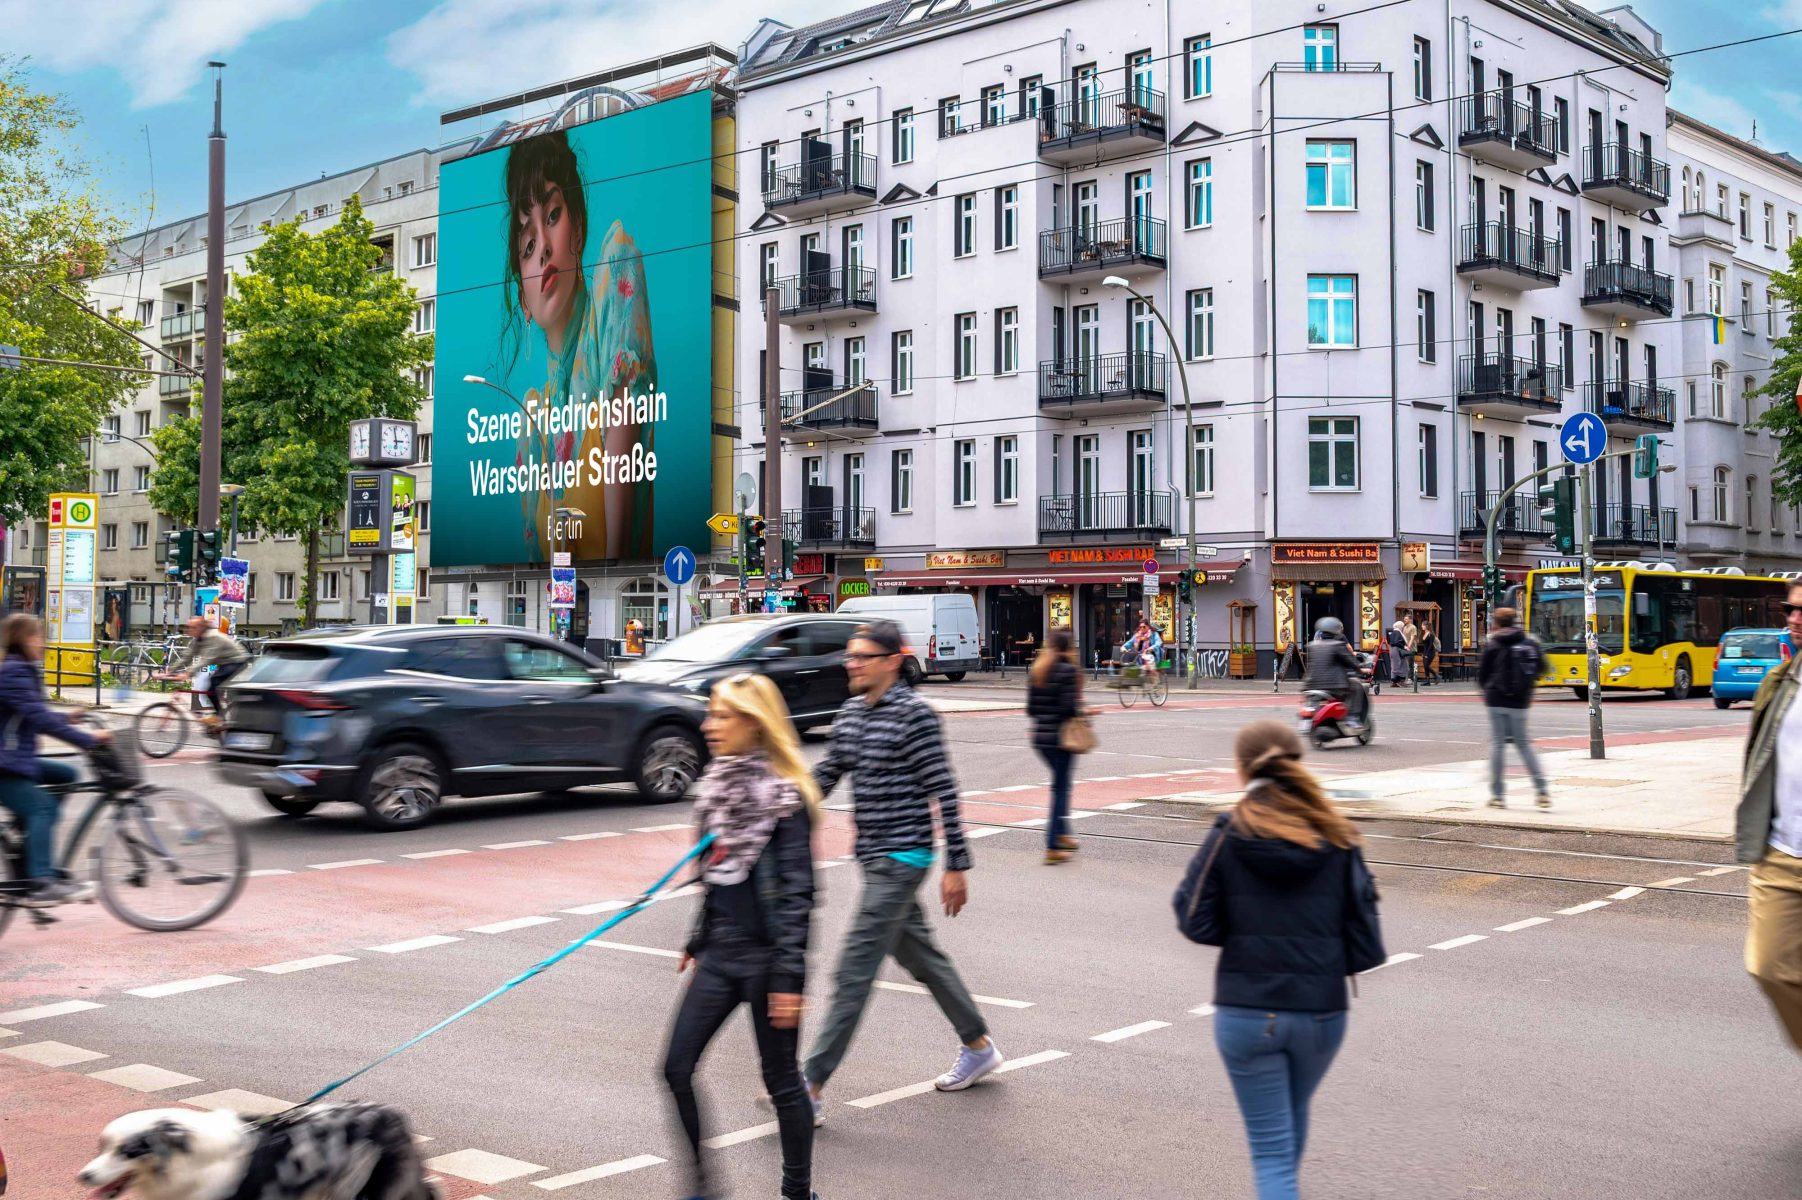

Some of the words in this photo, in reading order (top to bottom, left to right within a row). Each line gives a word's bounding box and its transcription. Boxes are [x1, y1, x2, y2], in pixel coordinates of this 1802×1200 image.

[467, 408, 521, 444] Szene
[526, 383, 668, 437] Friedrichshain
[470, 454, 584, 497] Warschauer
[588, 442, 657, 487] Straße
[76, 506, 85, 518] H
[933, 556, 945, 565] Viet
[948, 555, 962, 565] Nam
[963, 555, 969, 564] &
[970, 554, 988, 564] Sushi
[1048, 550, 1069, 563] VIET
[1070, 549, 1094, 562] NAM
[1095, 549, 1104, 561] &
[1105, 548, 1133, 561] SUSHI
[1135, 547, 1155, 560] BAR
[1286, 549, 1305, 557] Viet
[1306, 549, 1327, 557] Nam
[1329, 549, 1338, 557] &
[1339, 549, 1363, 557] Sushi
[840, 582, 870, 596] LOCKER
